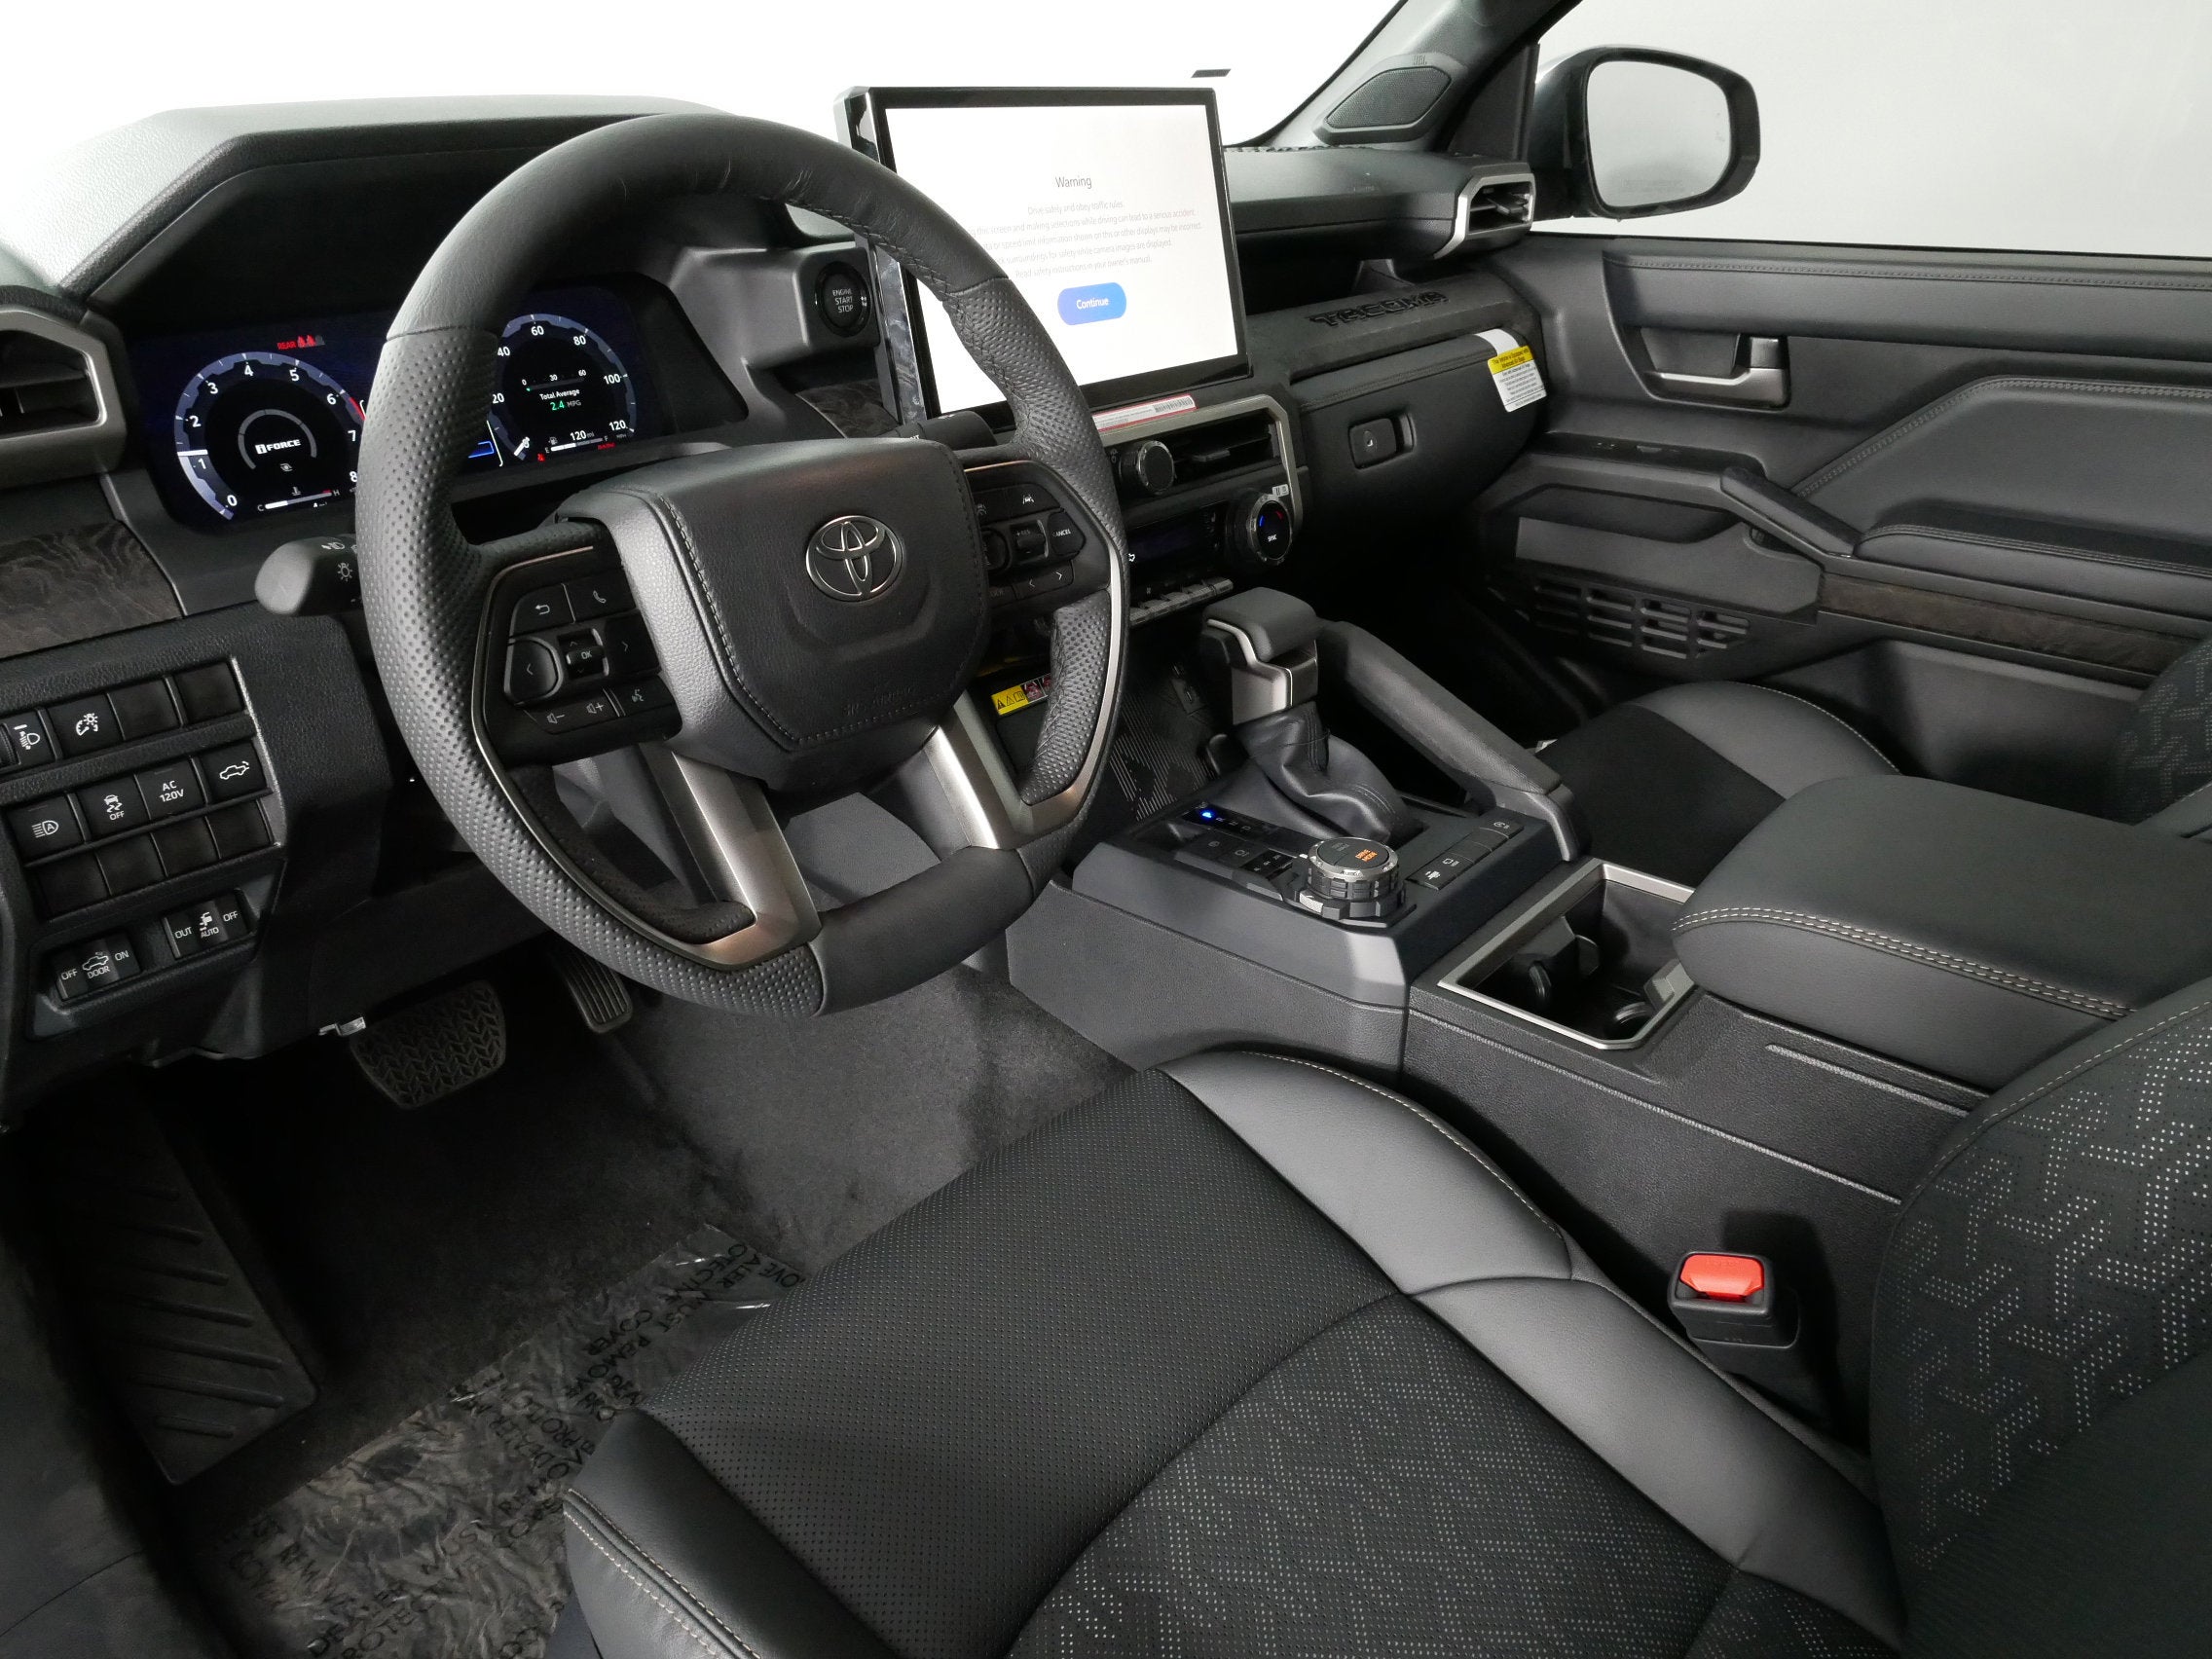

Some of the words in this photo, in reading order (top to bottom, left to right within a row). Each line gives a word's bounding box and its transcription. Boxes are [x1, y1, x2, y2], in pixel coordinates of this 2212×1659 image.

[1054, 175, 1092, 189] Warning
[1028, 206, 1043, 215] Drive
[1045, 204, 1061, 214] safely
[1064, 203, 1075, 212] and
[1091, 201, 1108, 210] traffic
[1027, 222, 1050, 232] making
[1129, 213, 1141, 222] lead
[1002, 240, 1021, 249] speed
[1038, 236, 1072, 245] information
[1137, 226, 1159, 236] displays
[1059, 249, 1076, 259] safety
[1094, 245, 1114, 254] camera
[1116, 243, 1135, 252] images
[1015, 269, 1031, 278] Read
[1034, 267, 1051, 276] safety
[1052, 264, 1087, 274] instructions
[1094, 261, 1106, 271] your
[835, 296, 853, 305] START
[1076, 297, 1109, 310] Continue
[1309, 291, 1450, 326] TACOMA
[532, 325, 543, 336] 60
[277, 341, 296, 350] REAR
[573, 335, 586, 346] 80
[498, 347, 510, 356] 40
[244, 365, 253, 377] 4
[289, 369, 300, 382] 5
[604, 374, 621, 385] 100
[207, 382, 218, 394] 3
[326, 393, 337, 405] 6
[493, 393, 504, 404] 20
[539, 392, 555, 401] Total
[556, 389, 580, 399] Average
[550, 400, 565, 411] 2.4
[190, 415, 202, 427] 2
[609, 420, 626, 431] 120
[348, 429, 356, 442] 7
[571, 430, 586, 441] 120
[198, 458, 206, 469] 1
[349, 470, 357, 483] 8
[227, 494, 238, 506] 0
[1051, 529, 1071, 537] CANCEL
[581, 649, 592, 659] OK
[163, 781, 177, 791] AC
[160, 789, 185, 802] 120V
[109, 810, 126, 821] OFF
[1355, 849, 1371, 859] DRIVE
[1362, 851, 1378, 863] MODE
[223, 911, 239, 922] OFF
[174, 926, 193, 939] OUT
[200, 927, 219, 938] AUTO
[115, 950, 129, 962] ON
[60, 968, 78, 980] OFF
[87, 966, 111, 978] DOOR
[716, 1254, 761, 1288] ALER
